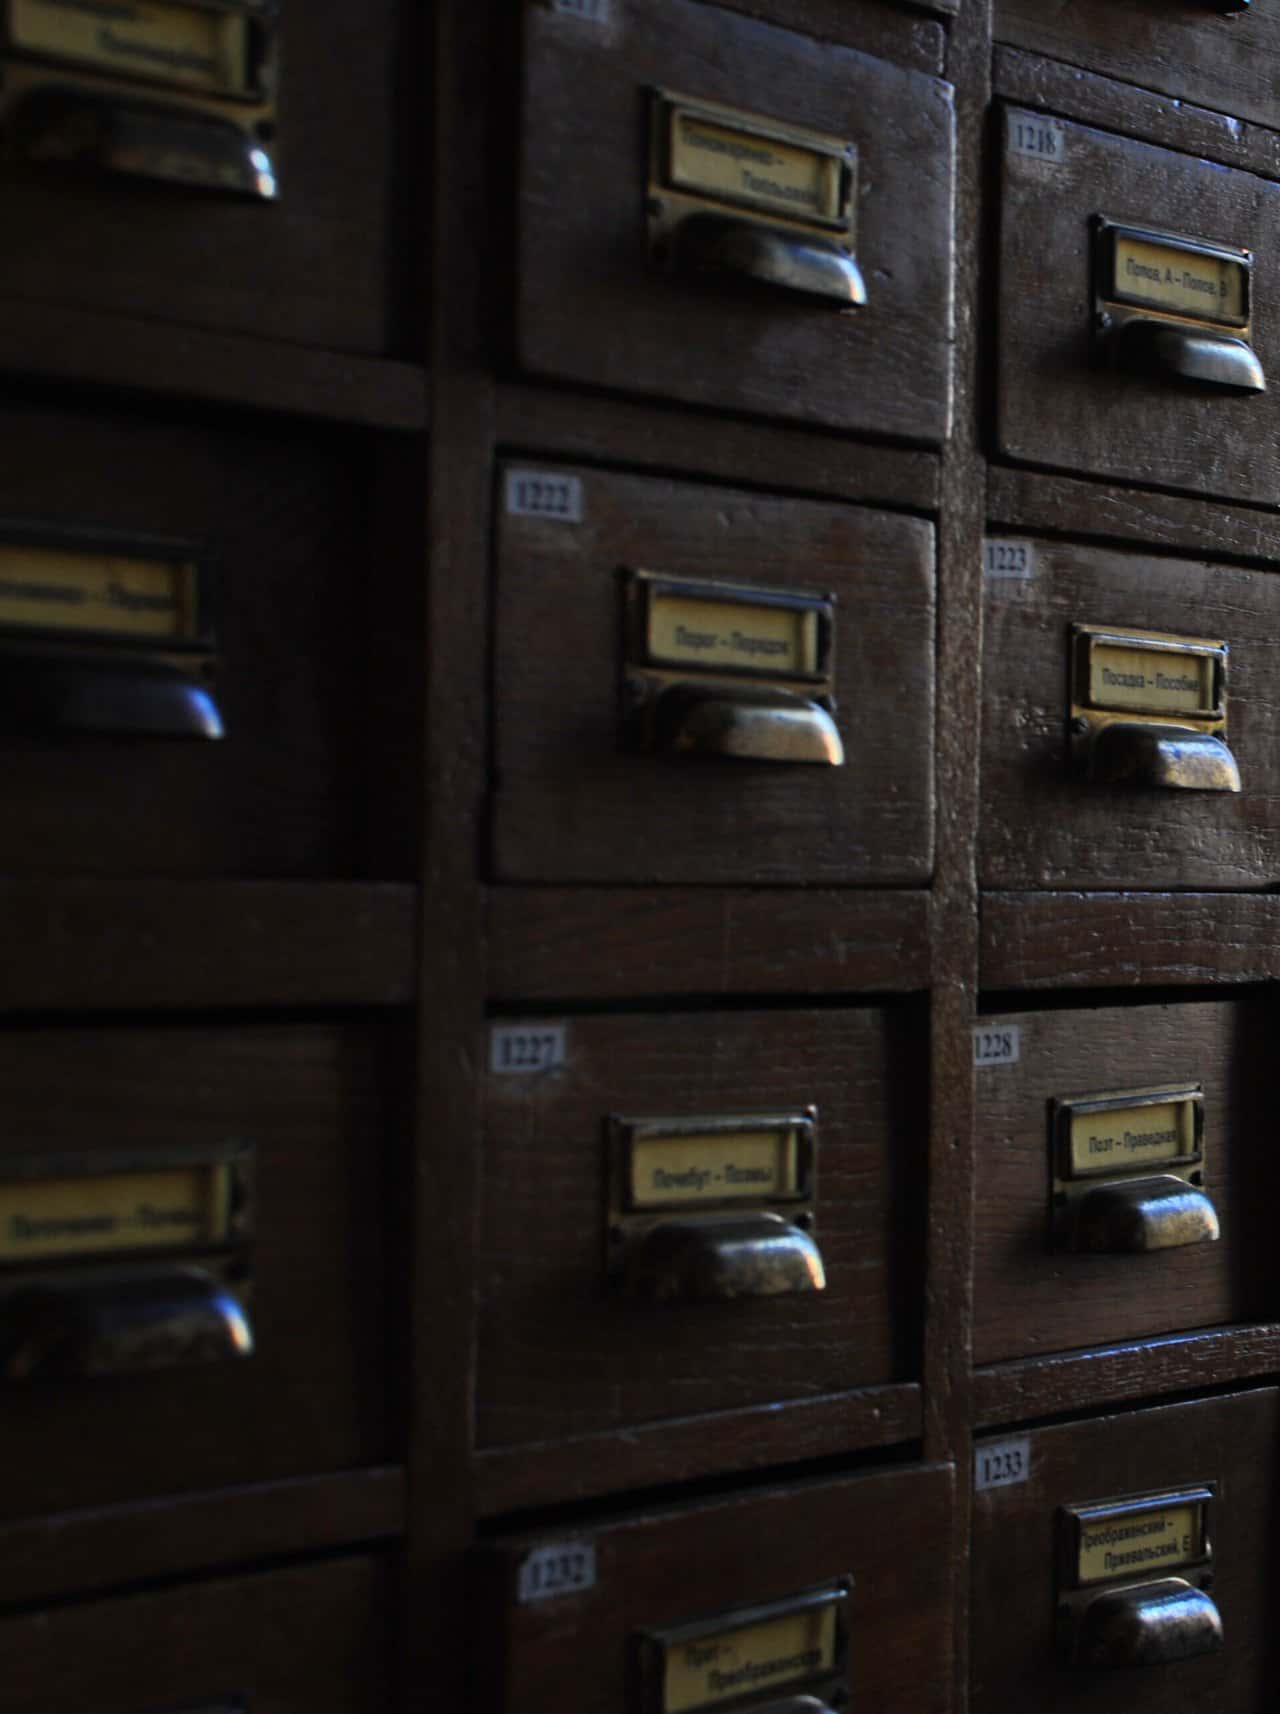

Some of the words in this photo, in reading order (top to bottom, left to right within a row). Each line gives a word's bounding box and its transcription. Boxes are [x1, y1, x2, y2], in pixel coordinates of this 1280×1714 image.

[515, 479, 570, 514] 1222
[986, 543, 1027, 570] 1223
[502, 1035, 557, 1065] 1227
[974, 1032, 1014, 1058] 1228
[983, 1451, 1023, 1483] 1233
[530, 1553, 586, 1590] 1232
